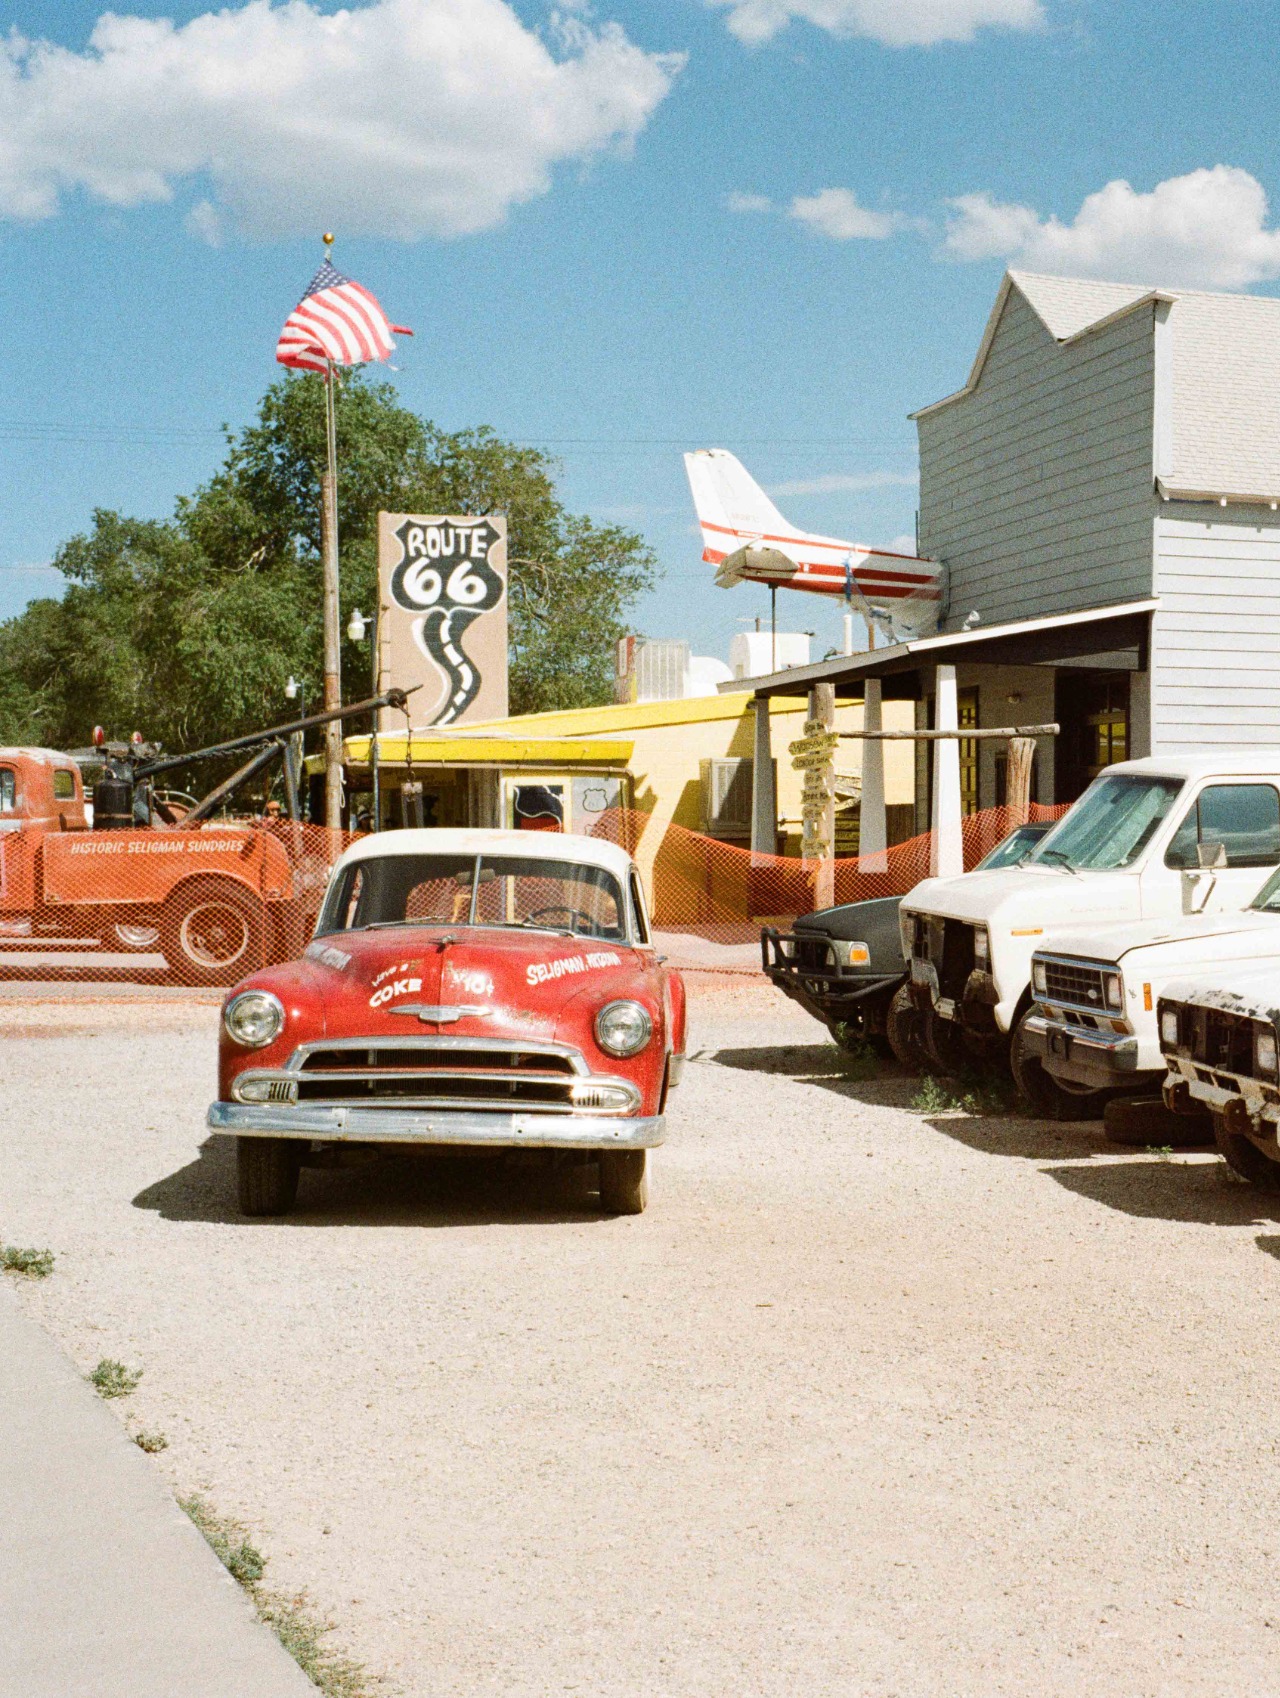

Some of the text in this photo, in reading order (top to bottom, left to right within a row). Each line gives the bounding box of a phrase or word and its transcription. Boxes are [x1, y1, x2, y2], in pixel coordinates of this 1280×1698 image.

[407, 526, 487, 559] ROUTE
[402, 557, 488, 605] 66
[71, 840, 245, 854] HISTORIC SELIGMAN SUNDRIES
[369, 978, 423, 1008] COKE
